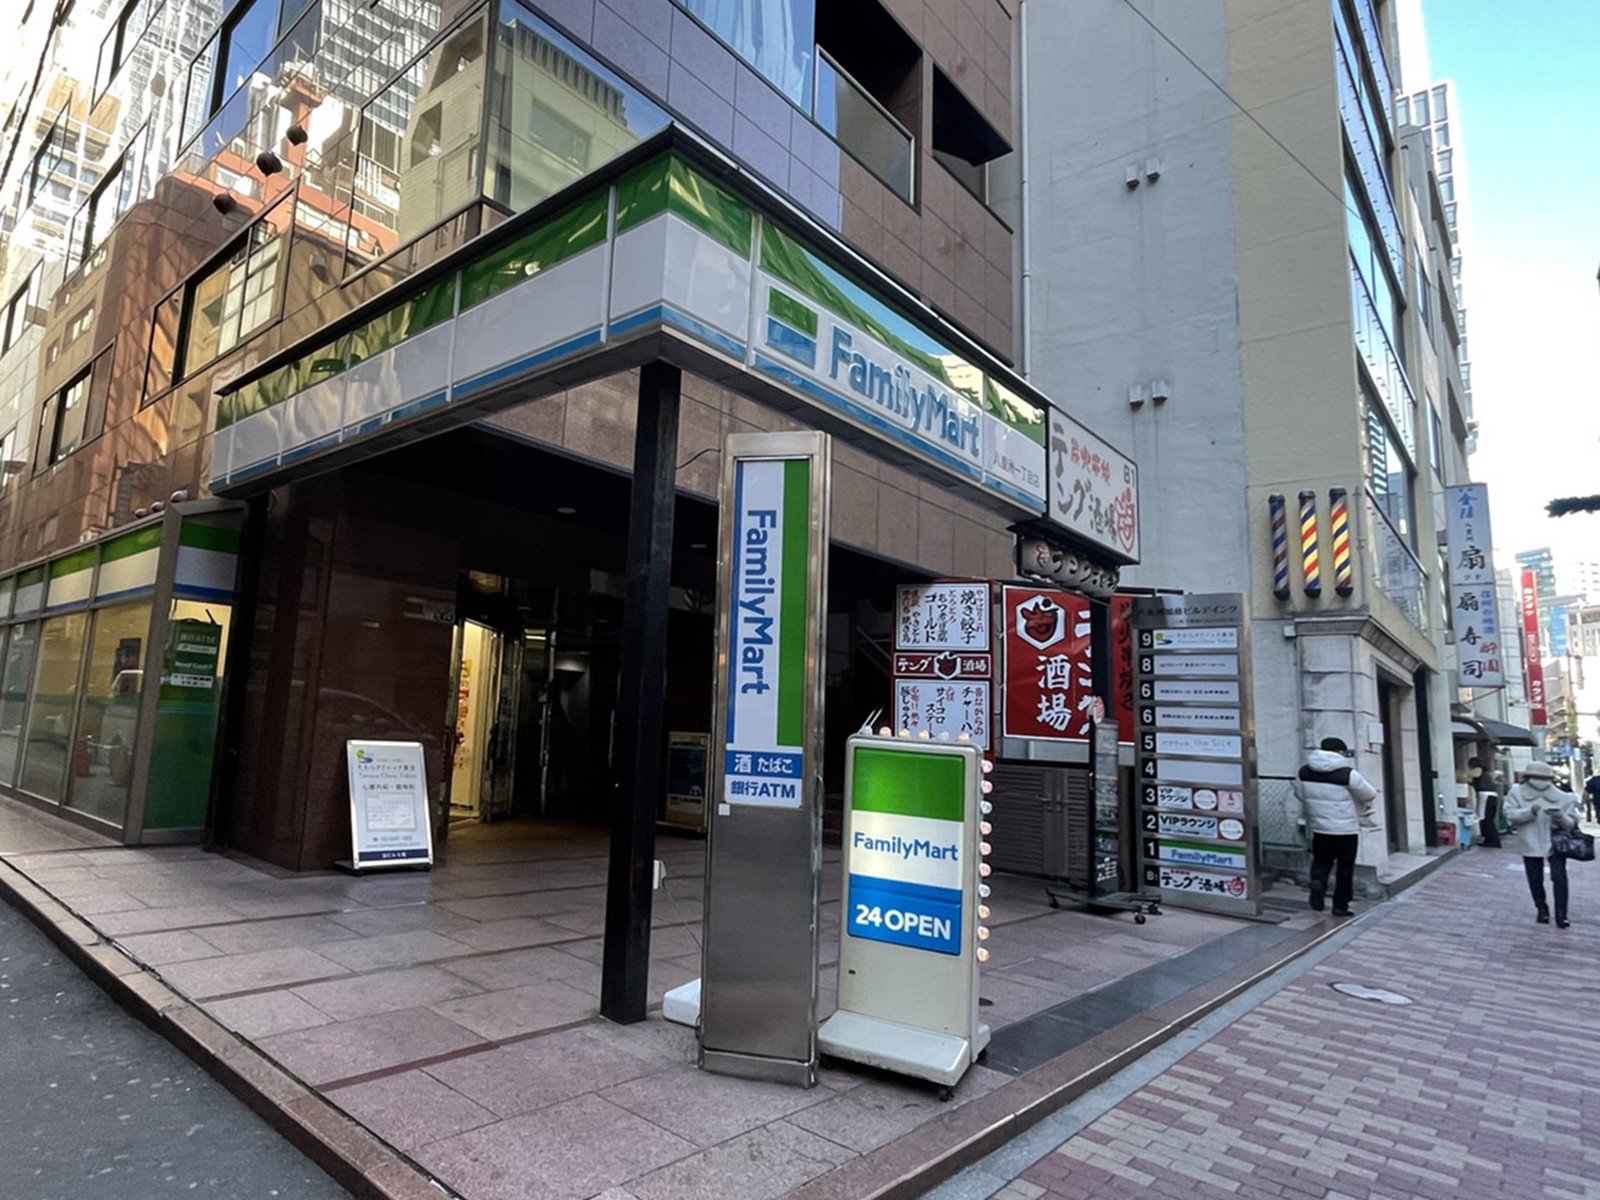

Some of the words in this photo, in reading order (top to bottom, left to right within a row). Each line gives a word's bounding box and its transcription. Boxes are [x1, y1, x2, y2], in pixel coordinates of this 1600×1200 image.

[829, 324, 981, 456] FamilyMart
[739, 509, 776, 694] FamilyMart
[960, 589, 976, 645] 焼き餃子
[1142, 632, 1151, 647] 9
[898, 656, 932, 672] テング
[1142, 658, 1151, 672] 8
[1036, 654, 1072, 731] 酒場
[1141, 683, 1151, 698] 6
[936, 687, 946, 724] サイコロ
[961, 686, 973, 738] チャーハ
[1143, 709, 1152, 723] 6
[1144, 735, 1154, 749] 5
[733, 753, 752, 774] 酒
[757, 755, 794, 774] たばこ
[1145, 762, 1155, 776] 4
[730, 779, 796, 799] 銀行ATM
[1146, 788, 1156, 803] 3
[1146, 815, 1156, 829] 2
[854, 832, 958, 861] FamilyMart
[1147, 842, 1155, 856] 1
[1171, 850, 1233, 865] FamilyMart
[884, 908, 951, 940] OPEN
